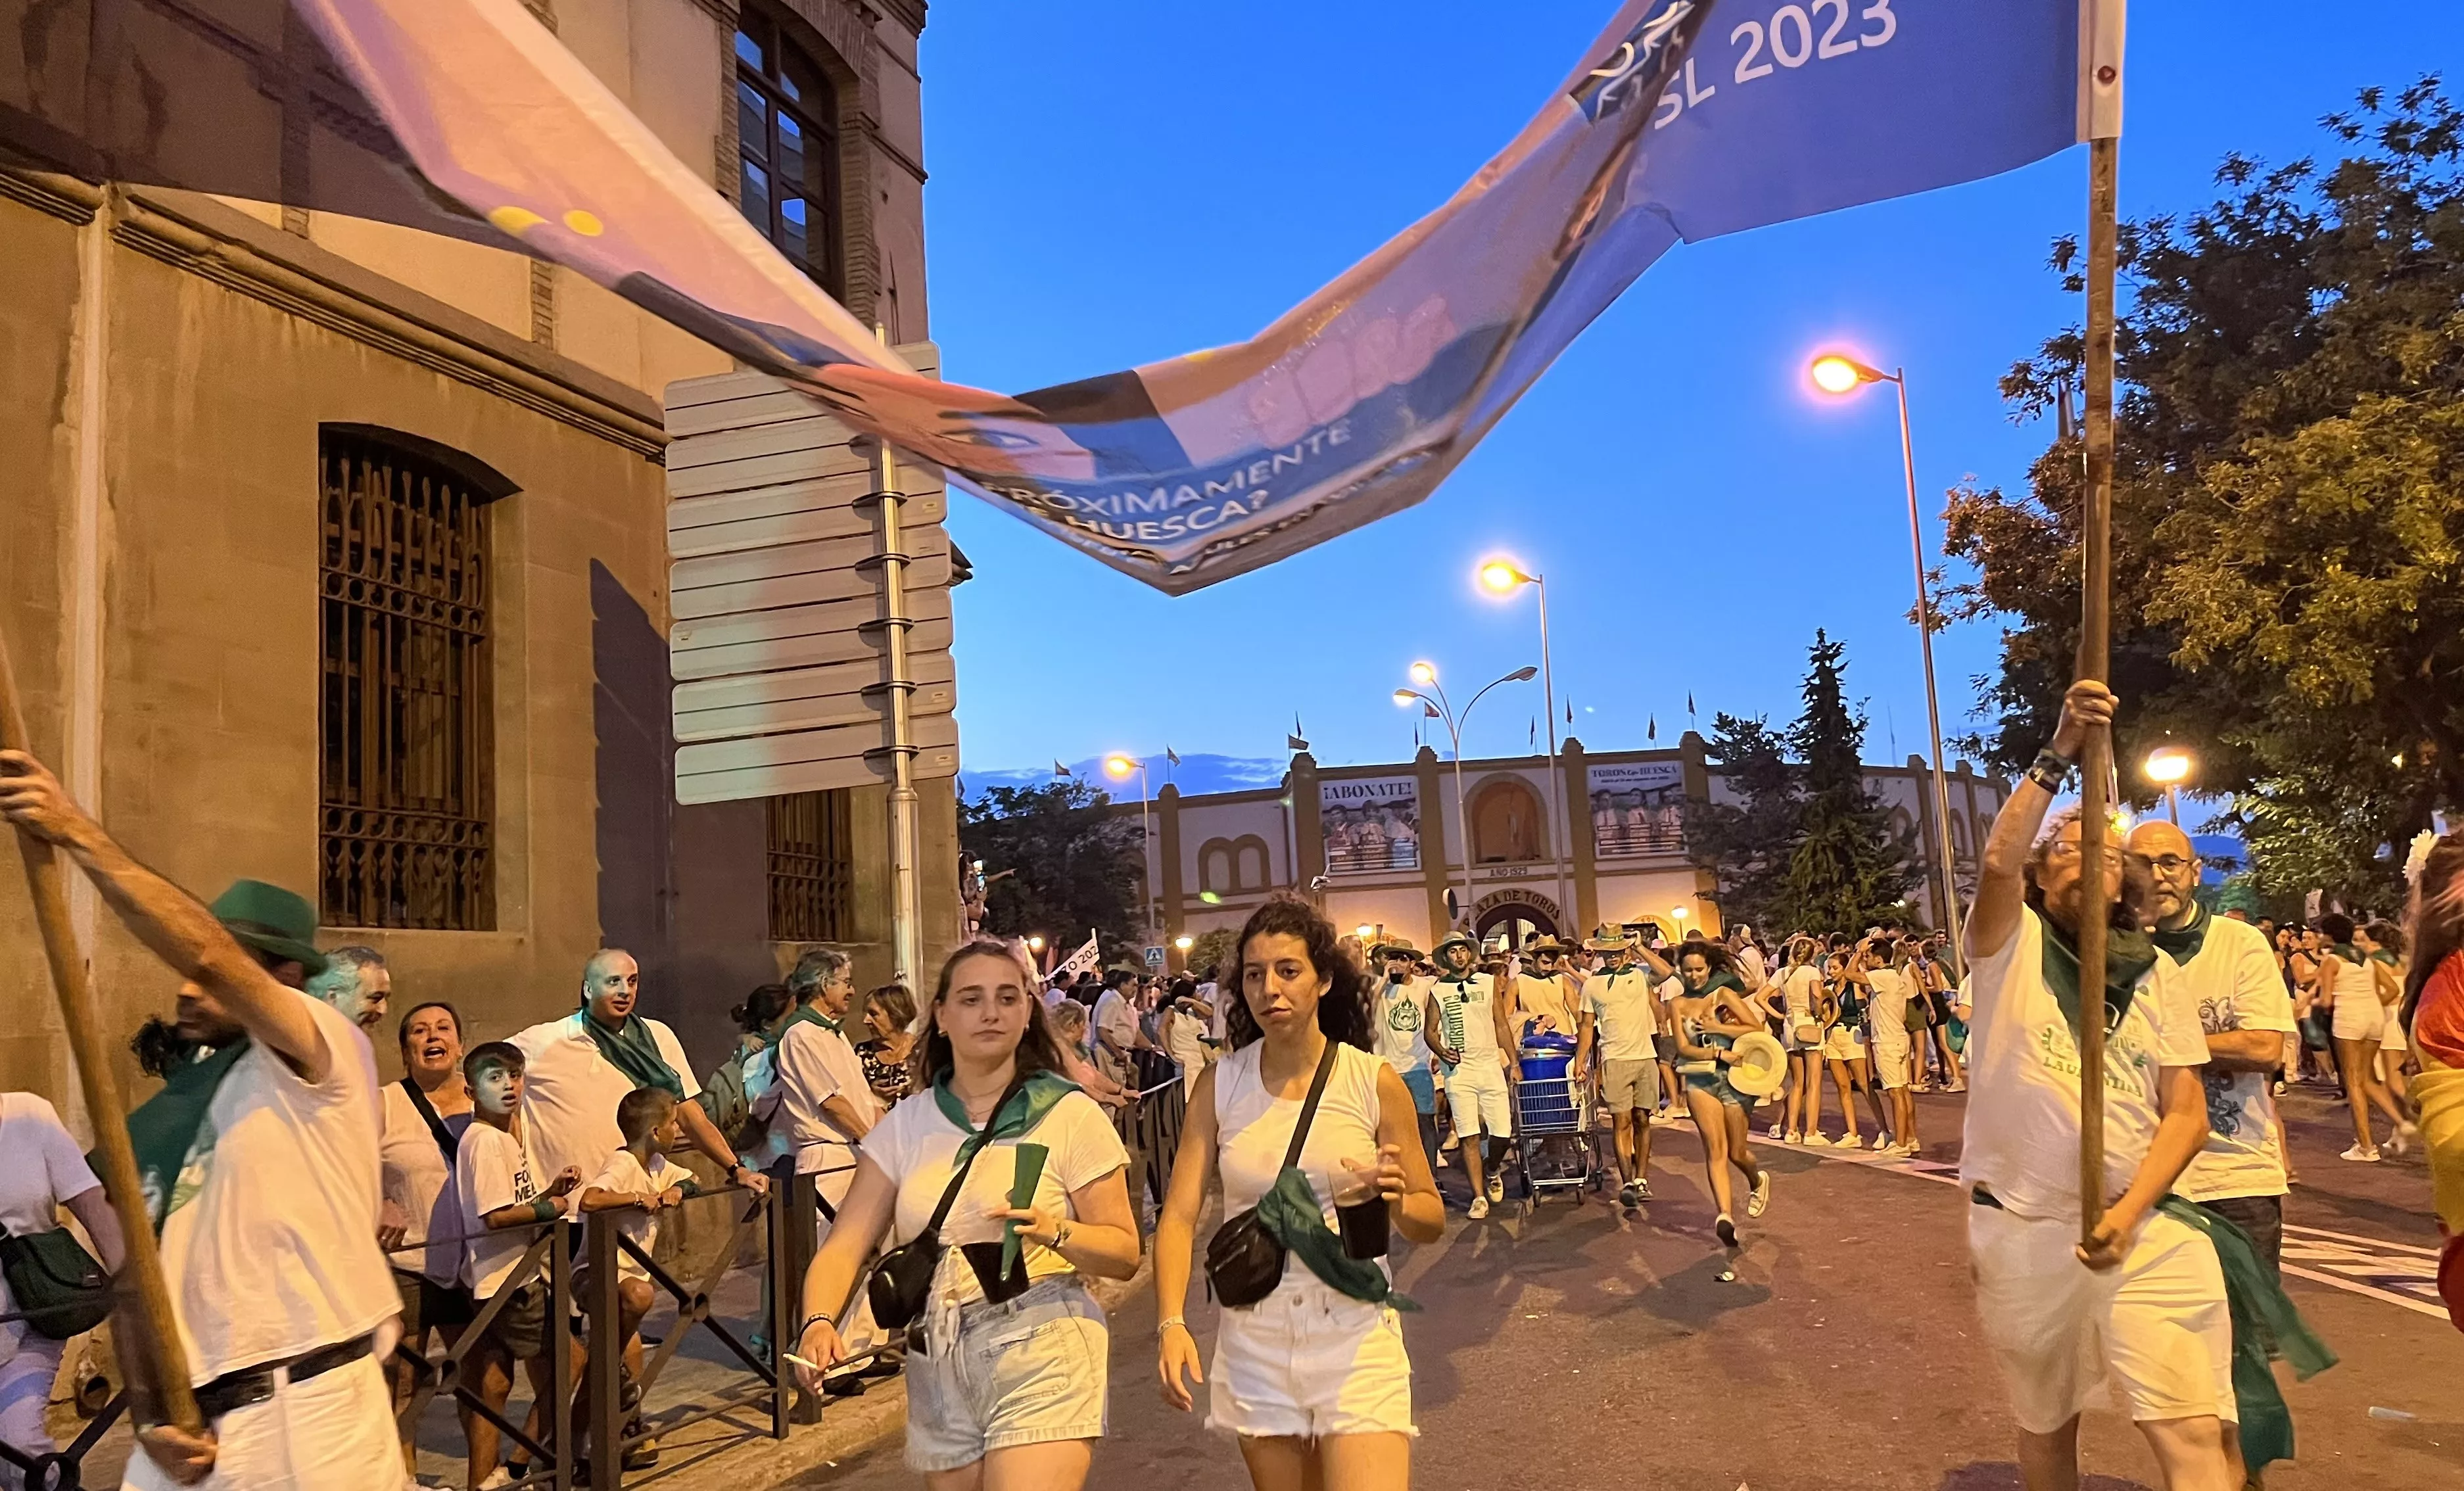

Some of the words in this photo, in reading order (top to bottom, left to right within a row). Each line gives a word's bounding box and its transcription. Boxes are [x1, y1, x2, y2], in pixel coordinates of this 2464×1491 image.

[1730, 0, 1897, 84] 2023
[1640, 766, 1676, 775] HUESCA
[1463, 895, 1501, 927] PAZA
[1504, 890, 1520, 902] DE
[1524, 891, 1561, 920] TOROS
